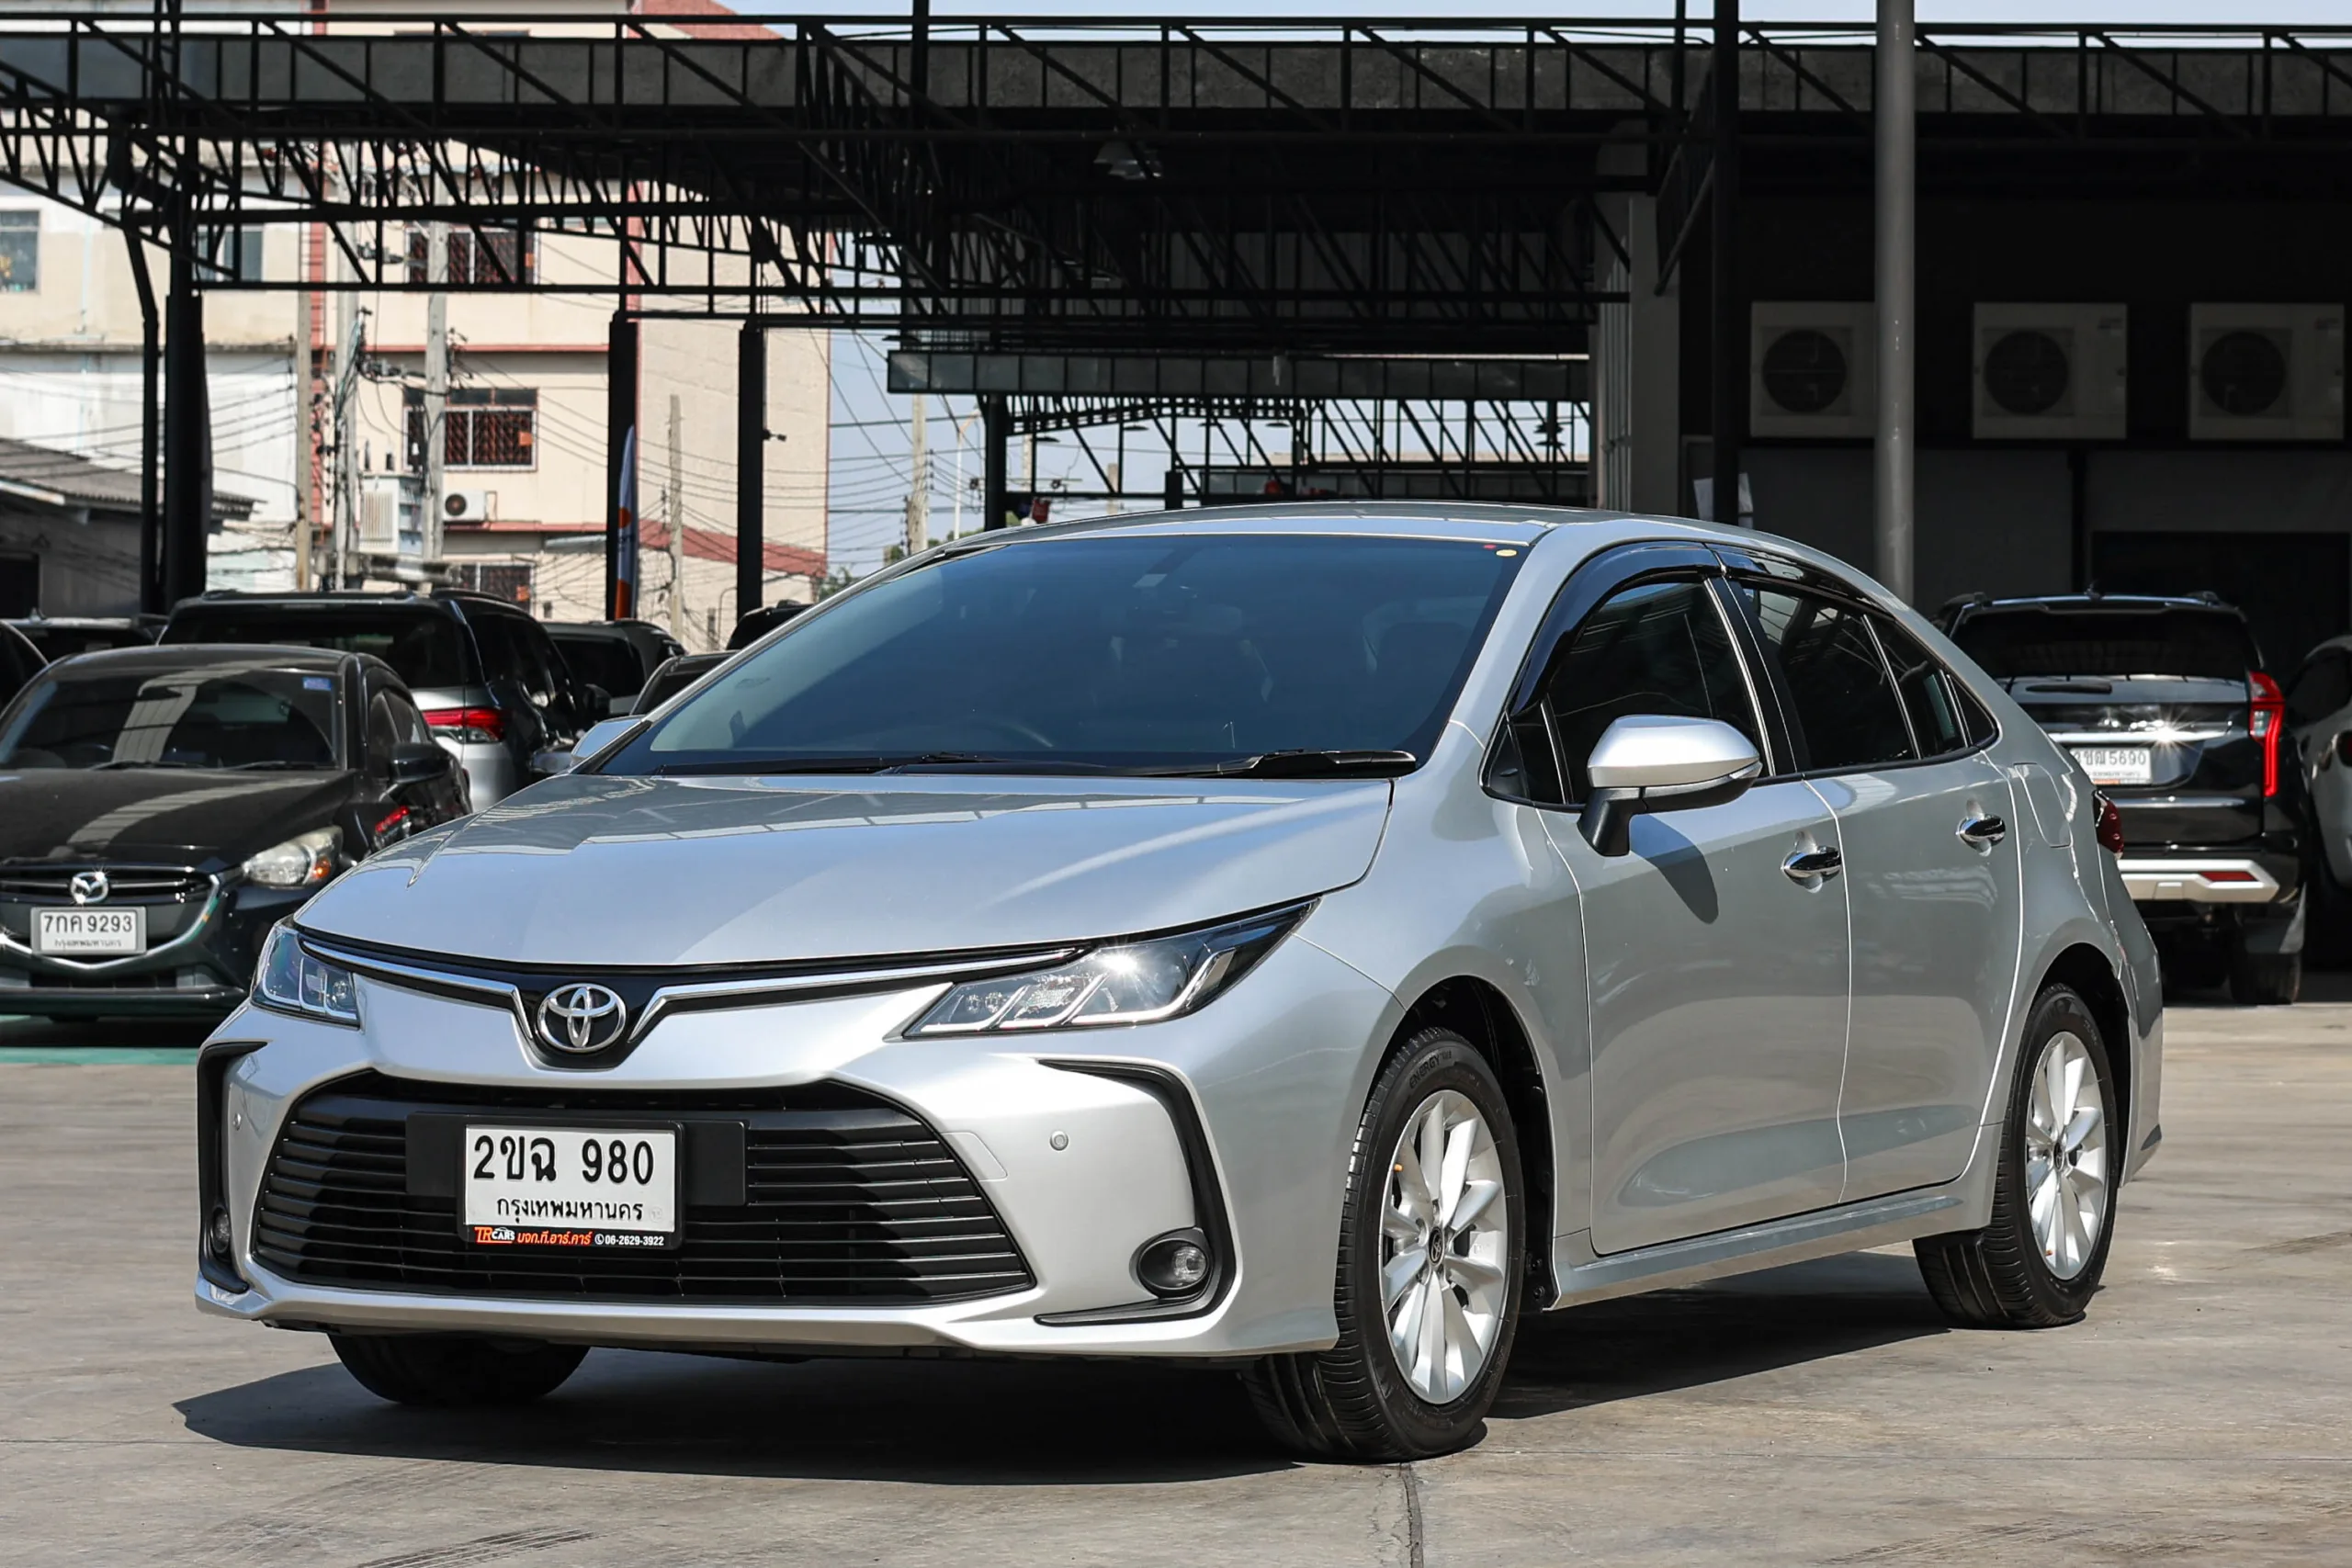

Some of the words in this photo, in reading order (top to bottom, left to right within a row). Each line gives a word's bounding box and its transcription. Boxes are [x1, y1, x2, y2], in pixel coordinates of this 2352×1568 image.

[2109, 749, 2147, 766] 5690
[43, 915, 83, 933] 7กค
[87, 915, 132, 933] 9293
[1408, 1054, 1440, 1089] ENERGY
[473, 1134, 557, 1181] 2ขฉ
[582, 1138, 654, 1185] 980
[496, 1198, 644, 1223] กรุงเทพมหานคร
